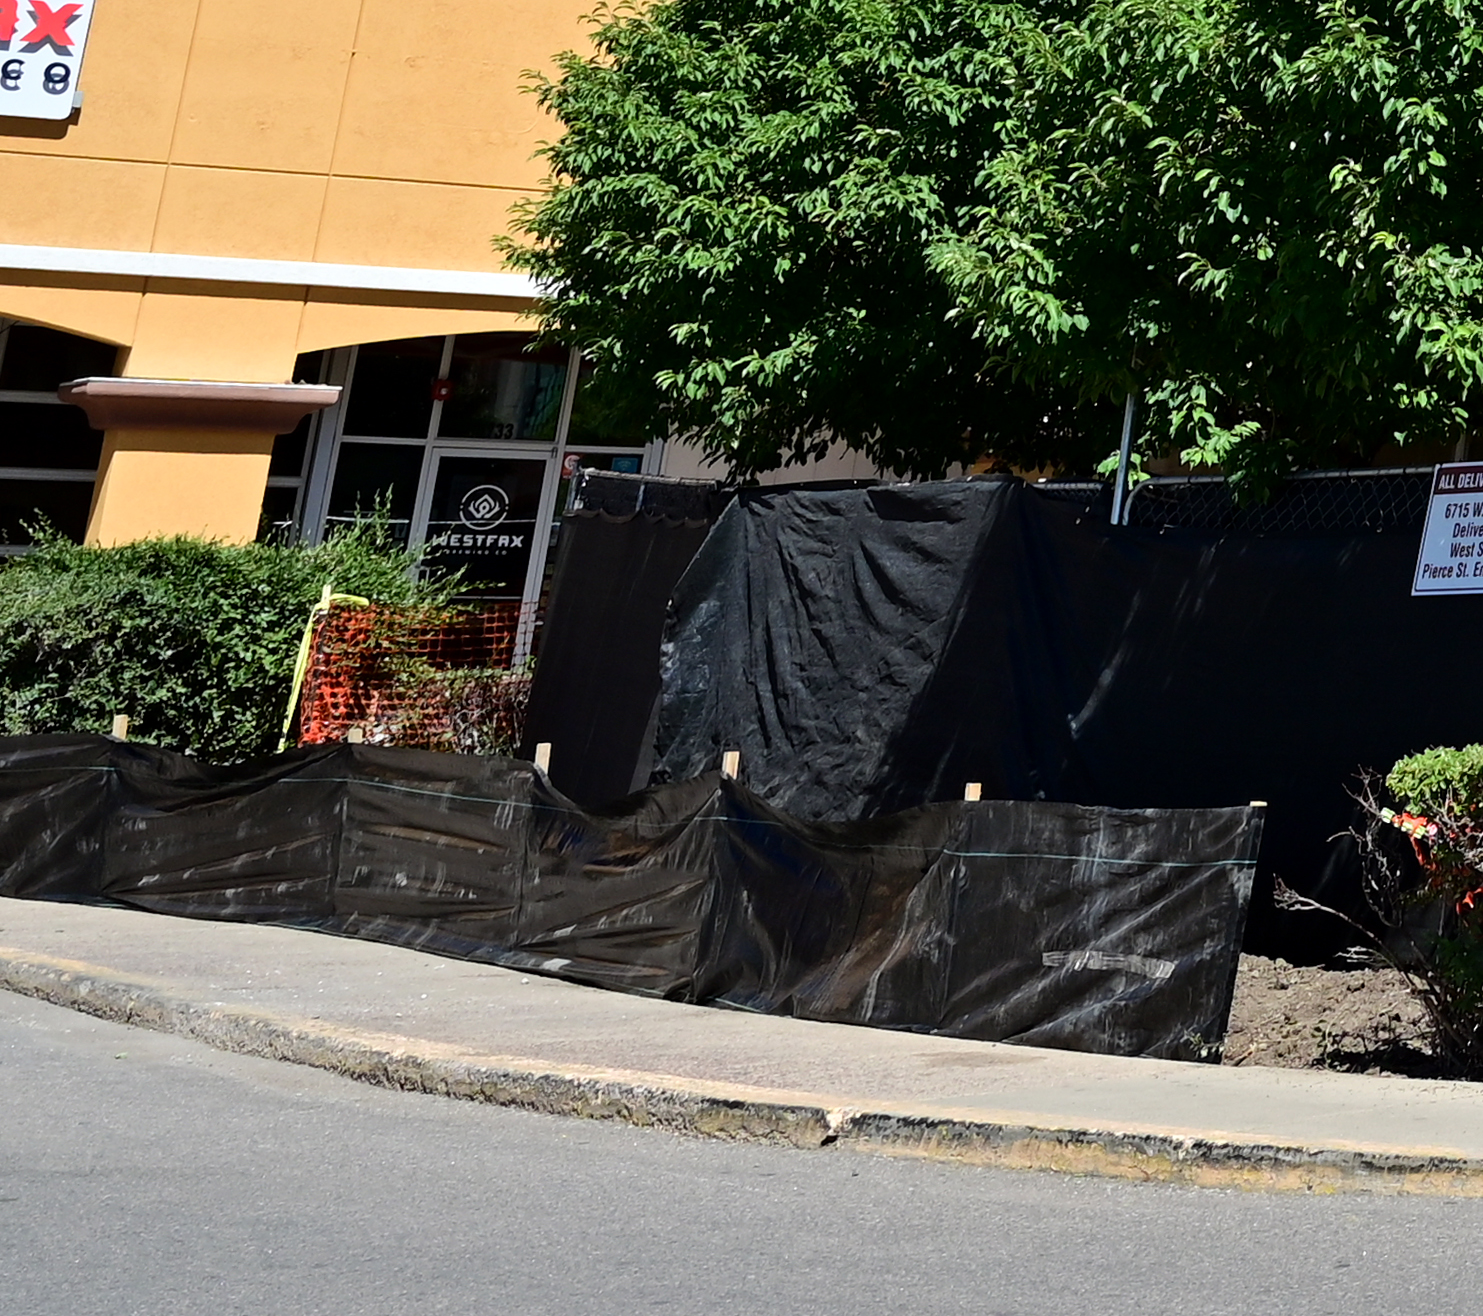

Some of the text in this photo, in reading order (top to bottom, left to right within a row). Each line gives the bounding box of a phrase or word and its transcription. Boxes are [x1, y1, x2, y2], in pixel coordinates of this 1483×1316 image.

[1438, 474, 1456, 490] ALL
[1444, 503, 1470, 519] 6715
[432, 534, 524, 548] WESTFAX
[1449, 542, 1475, 558] West
[1422, 563, 1453, 579] Pierce
[1456, 562, 1469, 578] St.
